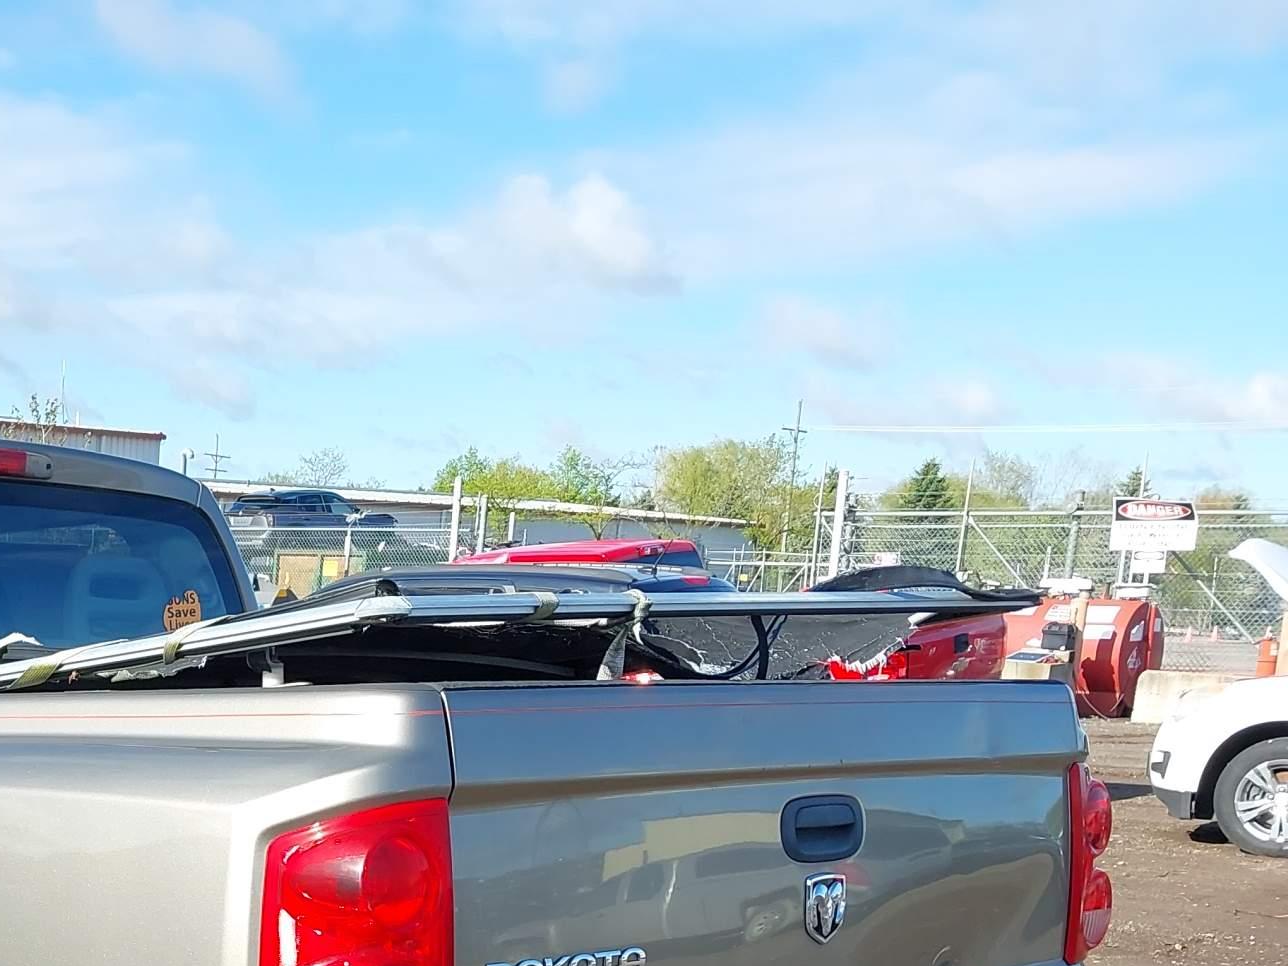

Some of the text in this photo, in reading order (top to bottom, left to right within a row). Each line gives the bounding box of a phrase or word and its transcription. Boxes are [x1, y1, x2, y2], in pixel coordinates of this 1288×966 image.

[1127, 503, 1184, 516] DANGER
[167, 606, 196, 618] Save
[169, 619, 194, 631] Liv
